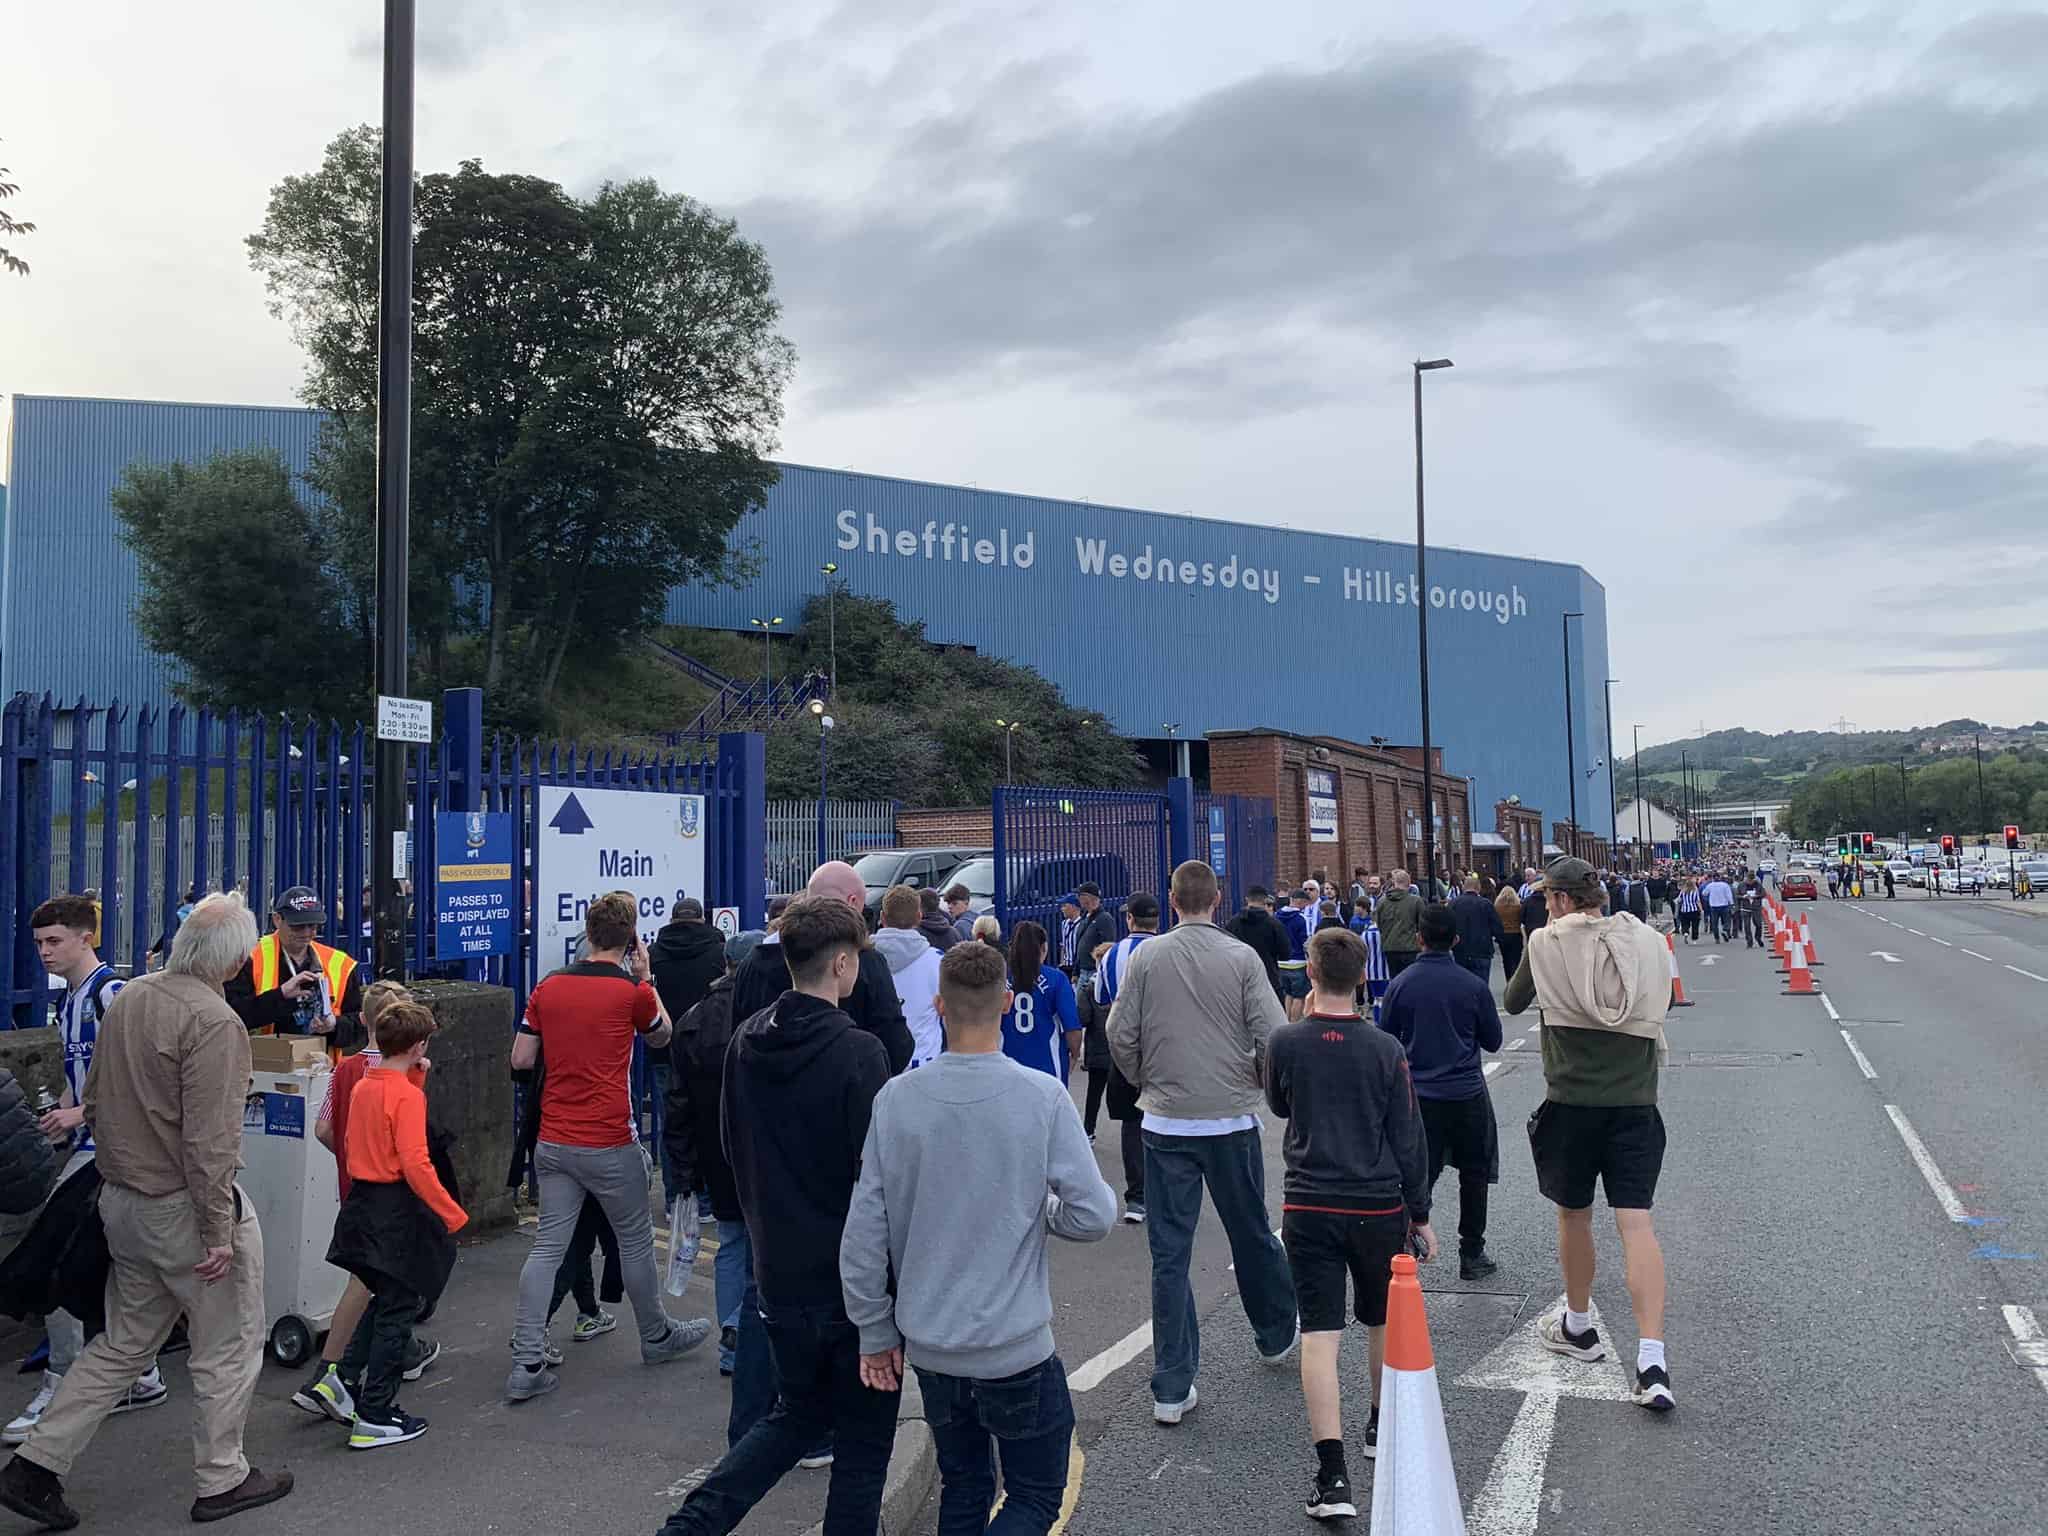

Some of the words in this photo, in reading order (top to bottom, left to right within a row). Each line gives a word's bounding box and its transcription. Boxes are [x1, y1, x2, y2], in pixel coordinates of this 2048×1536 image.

[837, 510, 1034, 569] Sheffield
[1075, 537, 1279, 603] Wednesday
[400, 702, 423, 711] loading
[392, 711, 405, 719] Mon
[600, 849, 653, 877] Main
[449, 895, 487, 907] PASSES
[489, 894, 502, 904] TO
[440, 912, 454, 923] BE
[457, 908, 510, 922] DISPLAYED
[722, 917, 729, 928] 5
[460, 926, 472, 937] AT
[475, 925, 493, 935] ALL
[462, 940, 491, 952] TIMES
[1014, 992, 1034, 1033] 8
